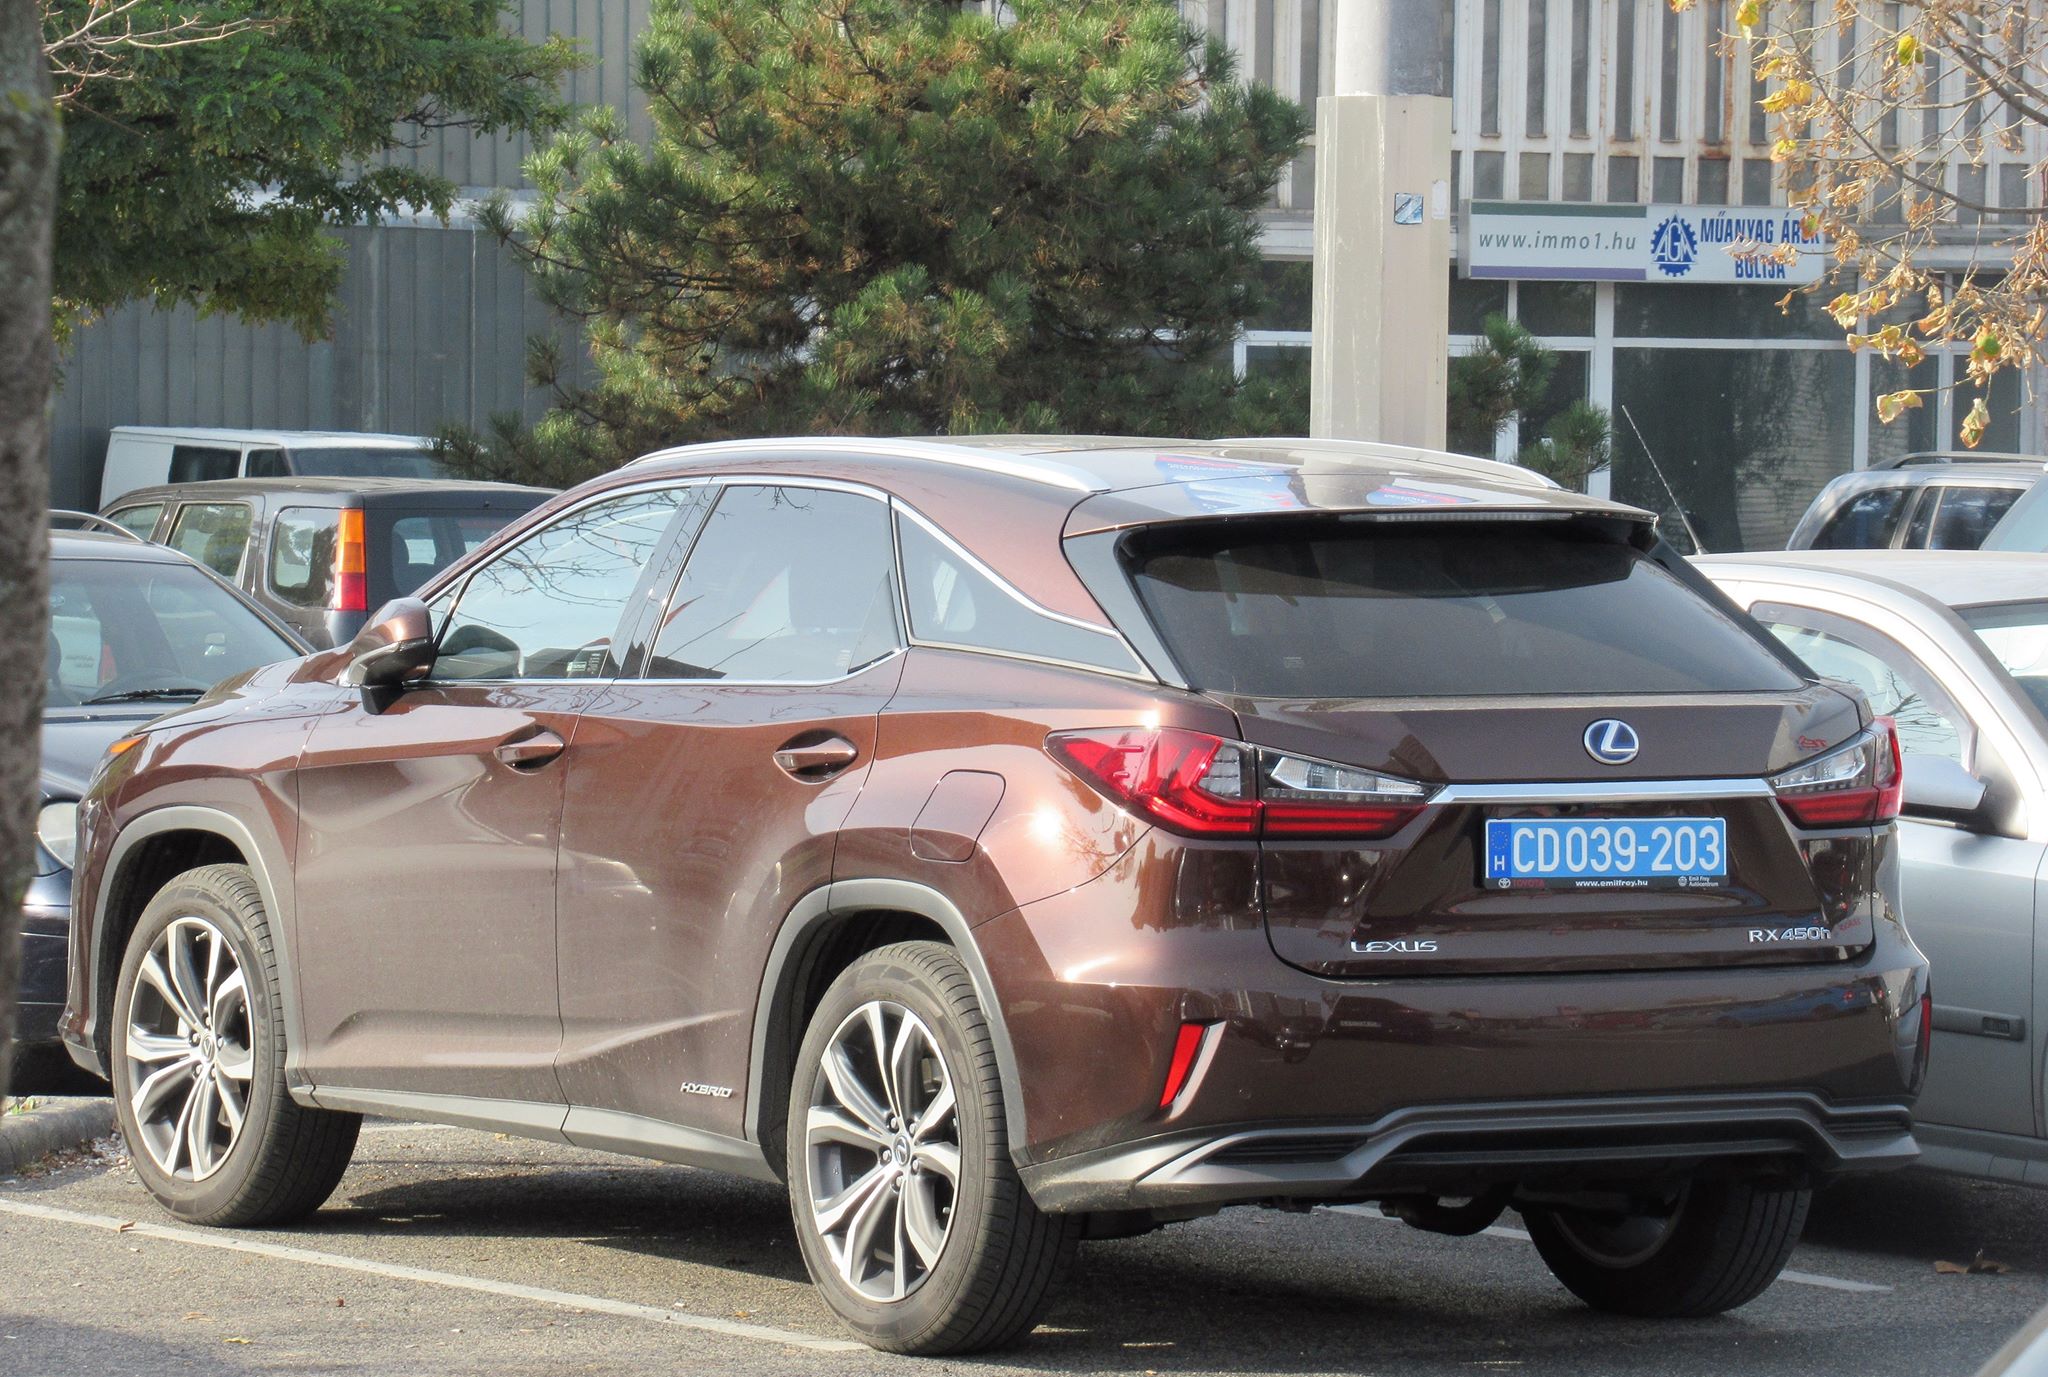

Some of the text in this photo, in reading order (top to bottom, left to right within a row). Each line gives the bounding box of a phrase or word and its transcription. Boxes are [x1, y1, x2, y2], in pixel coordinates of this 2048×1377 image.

[1700, 210, 1774, 243] MŰANYAG
[1479, 231, 1637, 250] www.immo1.hu
[1494, 855, 1505, 871] H
[1350, 940, 1438, 953] LEXUS
[680, 1082, 733, 1098] HYBRID
